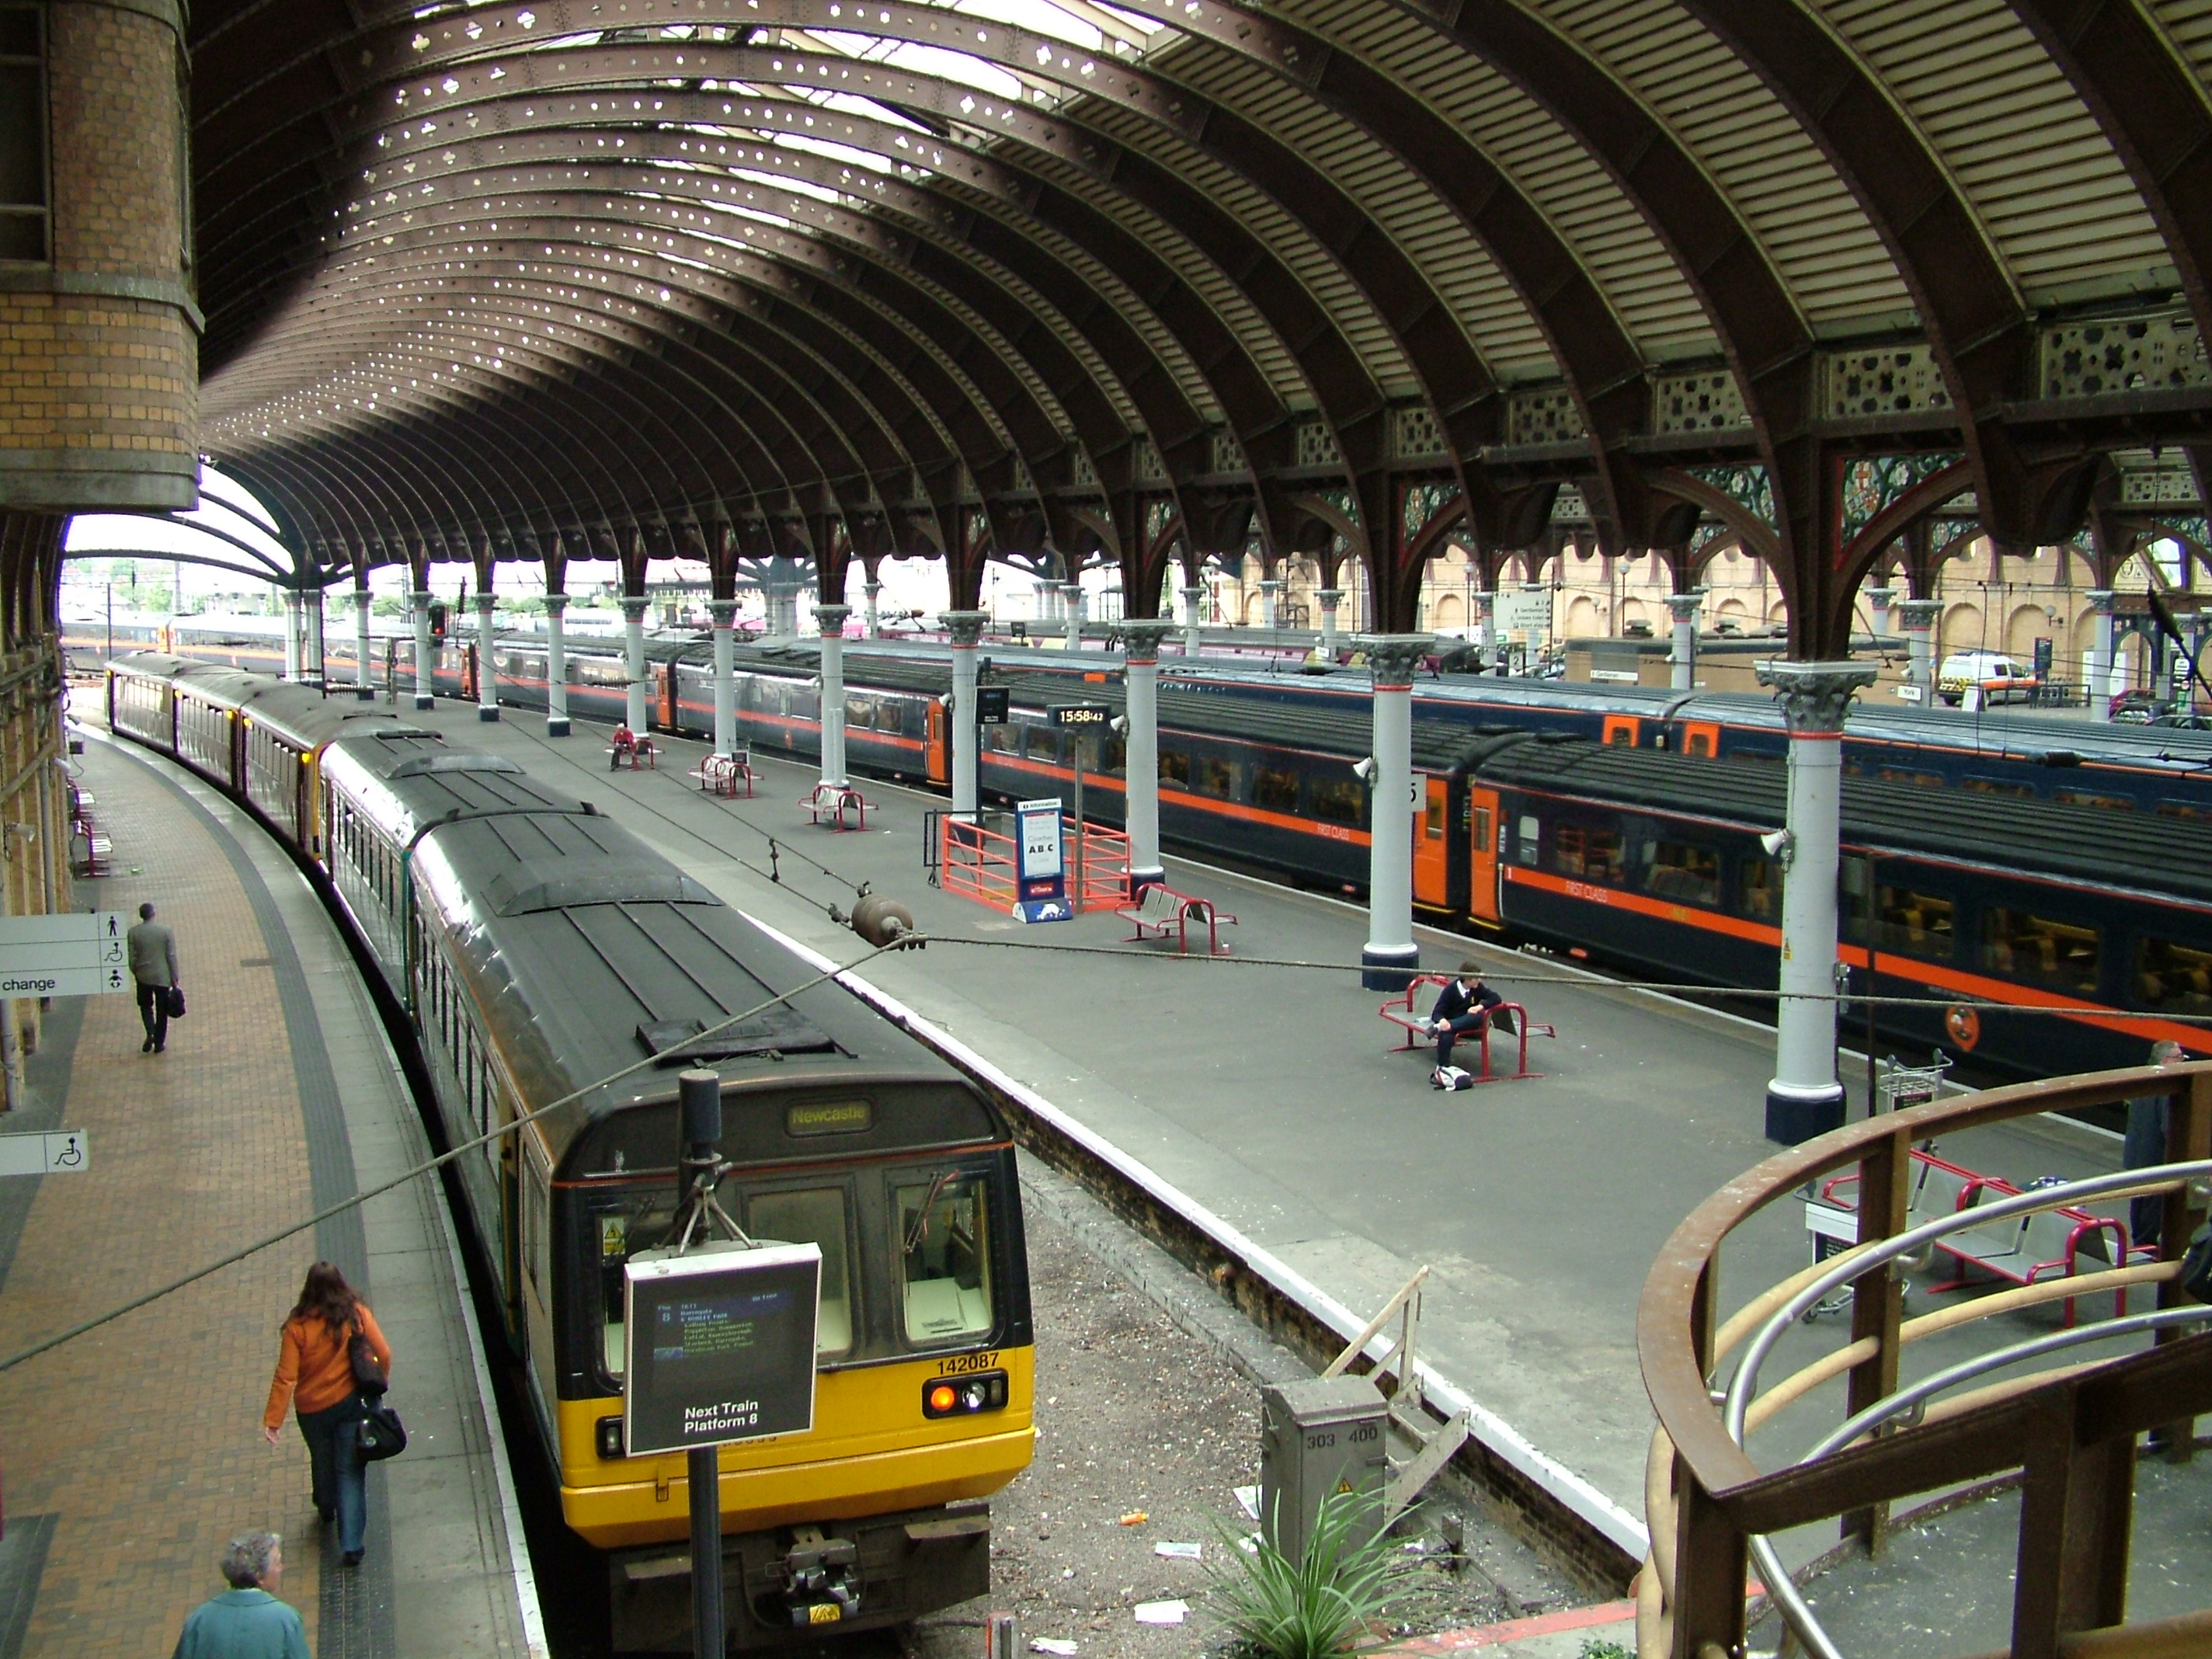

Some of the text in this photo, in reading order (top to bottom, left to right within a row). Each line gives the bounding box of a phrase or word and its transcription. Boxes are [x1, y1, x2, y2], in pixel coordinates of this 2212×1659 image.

[1514, 656, 1519, 666] 2
[1060, 710, 1104, 723] 15:58:42
[1565, 880, 1608, 904] FIRST CLASS
[2, 979, 55, 991] change
[793, 1106, 866, 1124] Newcastle
[937, 1352, 999, 1375] 142087
[685, 1400, 758, 1420] Next Train
[684, 1413, 758, 1434] Platform 8
[1307, 1427, 1377, 1449] 303 400
